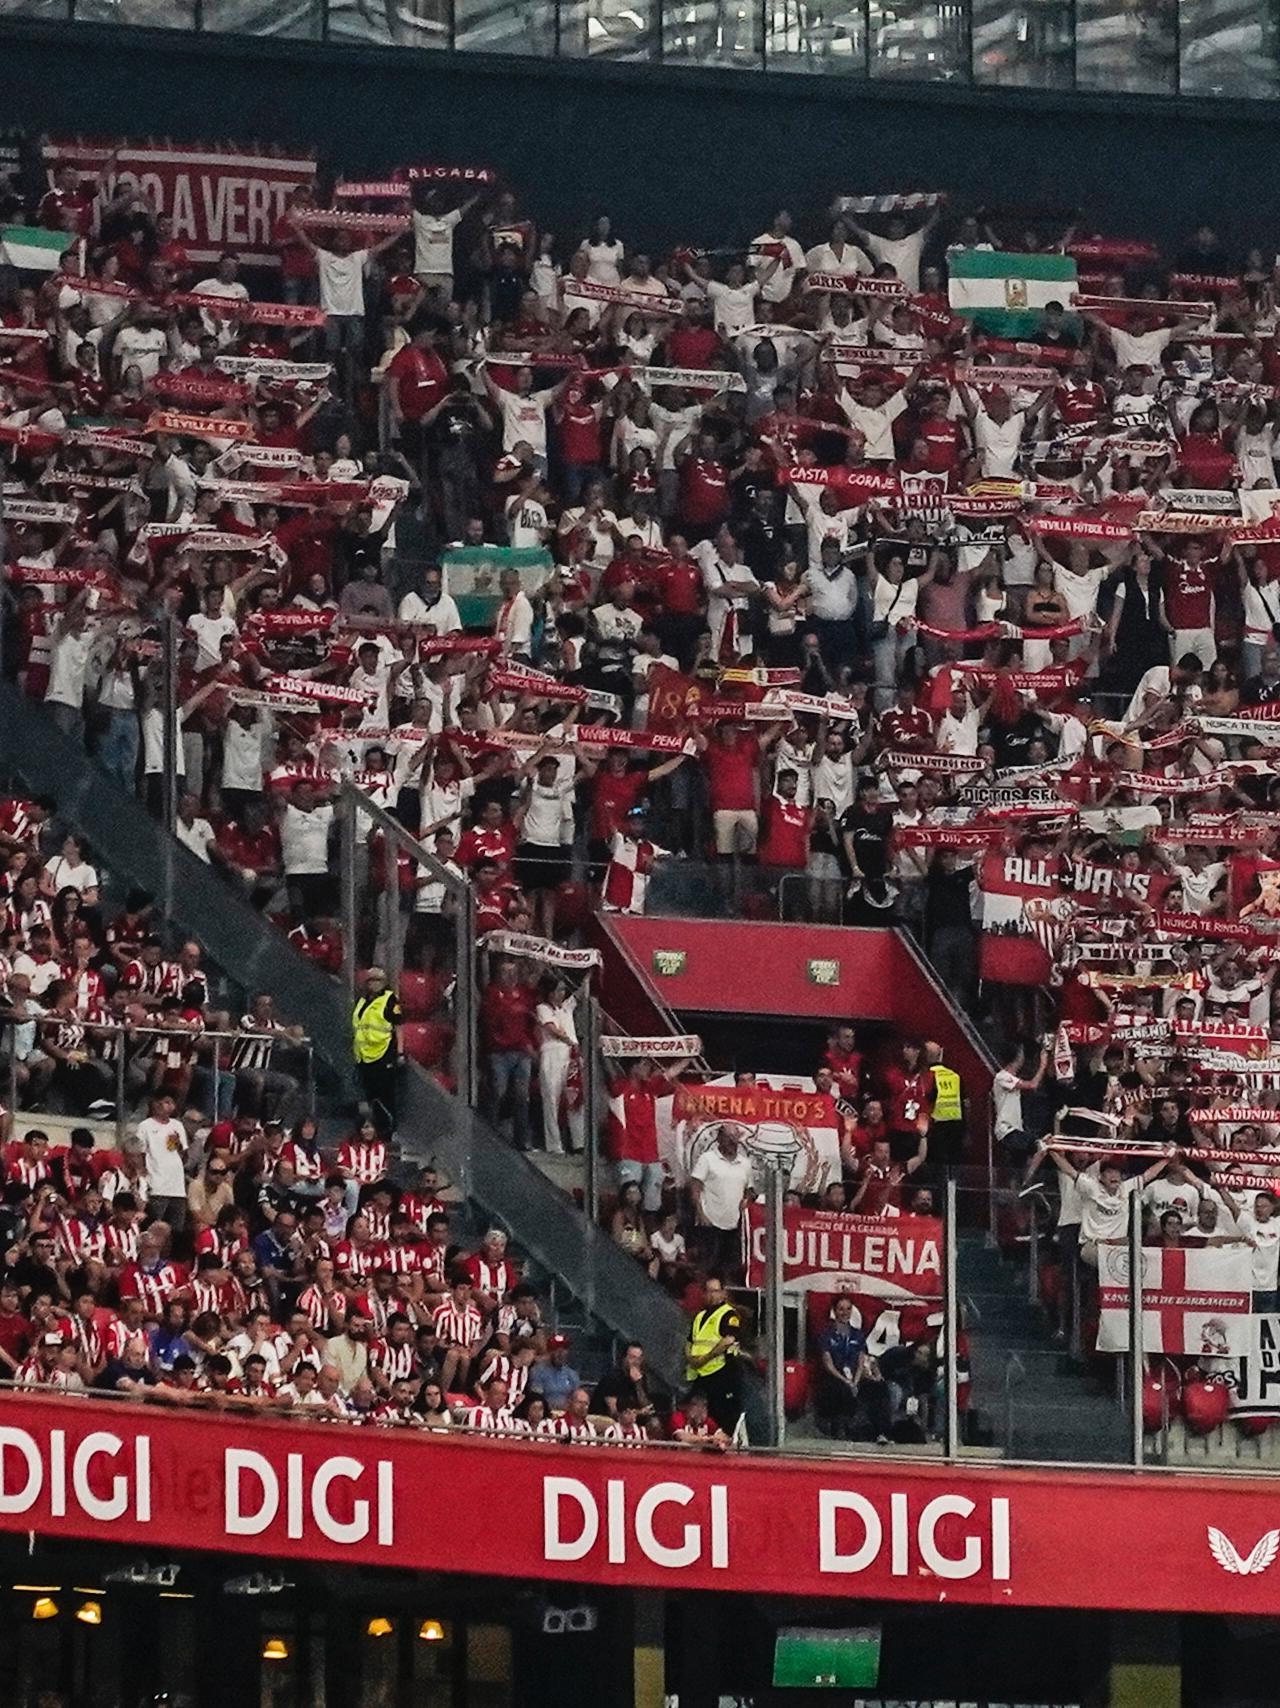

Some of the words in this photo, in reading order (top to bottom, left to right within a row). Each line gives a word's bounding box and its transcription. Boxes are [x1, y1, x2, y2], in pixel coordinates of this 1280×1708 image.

[171, 174, 198, 240] A
[789, 467, 829, 482] CASTA
[849, 473, 895, 490] CORAJE
[1162, 917, 1198, 930] NUNCA
[1200, 920, 1212, 931] TE
[1213, 922, 1250, 935] RINDAS
[621, 1039, 686, 1052] SUPERCOPA
[763, 1097, 826, 1120] TITO'S
[1190, 1109, 1230, 1122] VAYAS
[1232, 1109, 1279, 1121] DONDE
[226, 1449, 392, 1545] DIGI
[544, 1477, 727, 1567] DIGI
[820, 1490, 1009, 1579] DIGI
